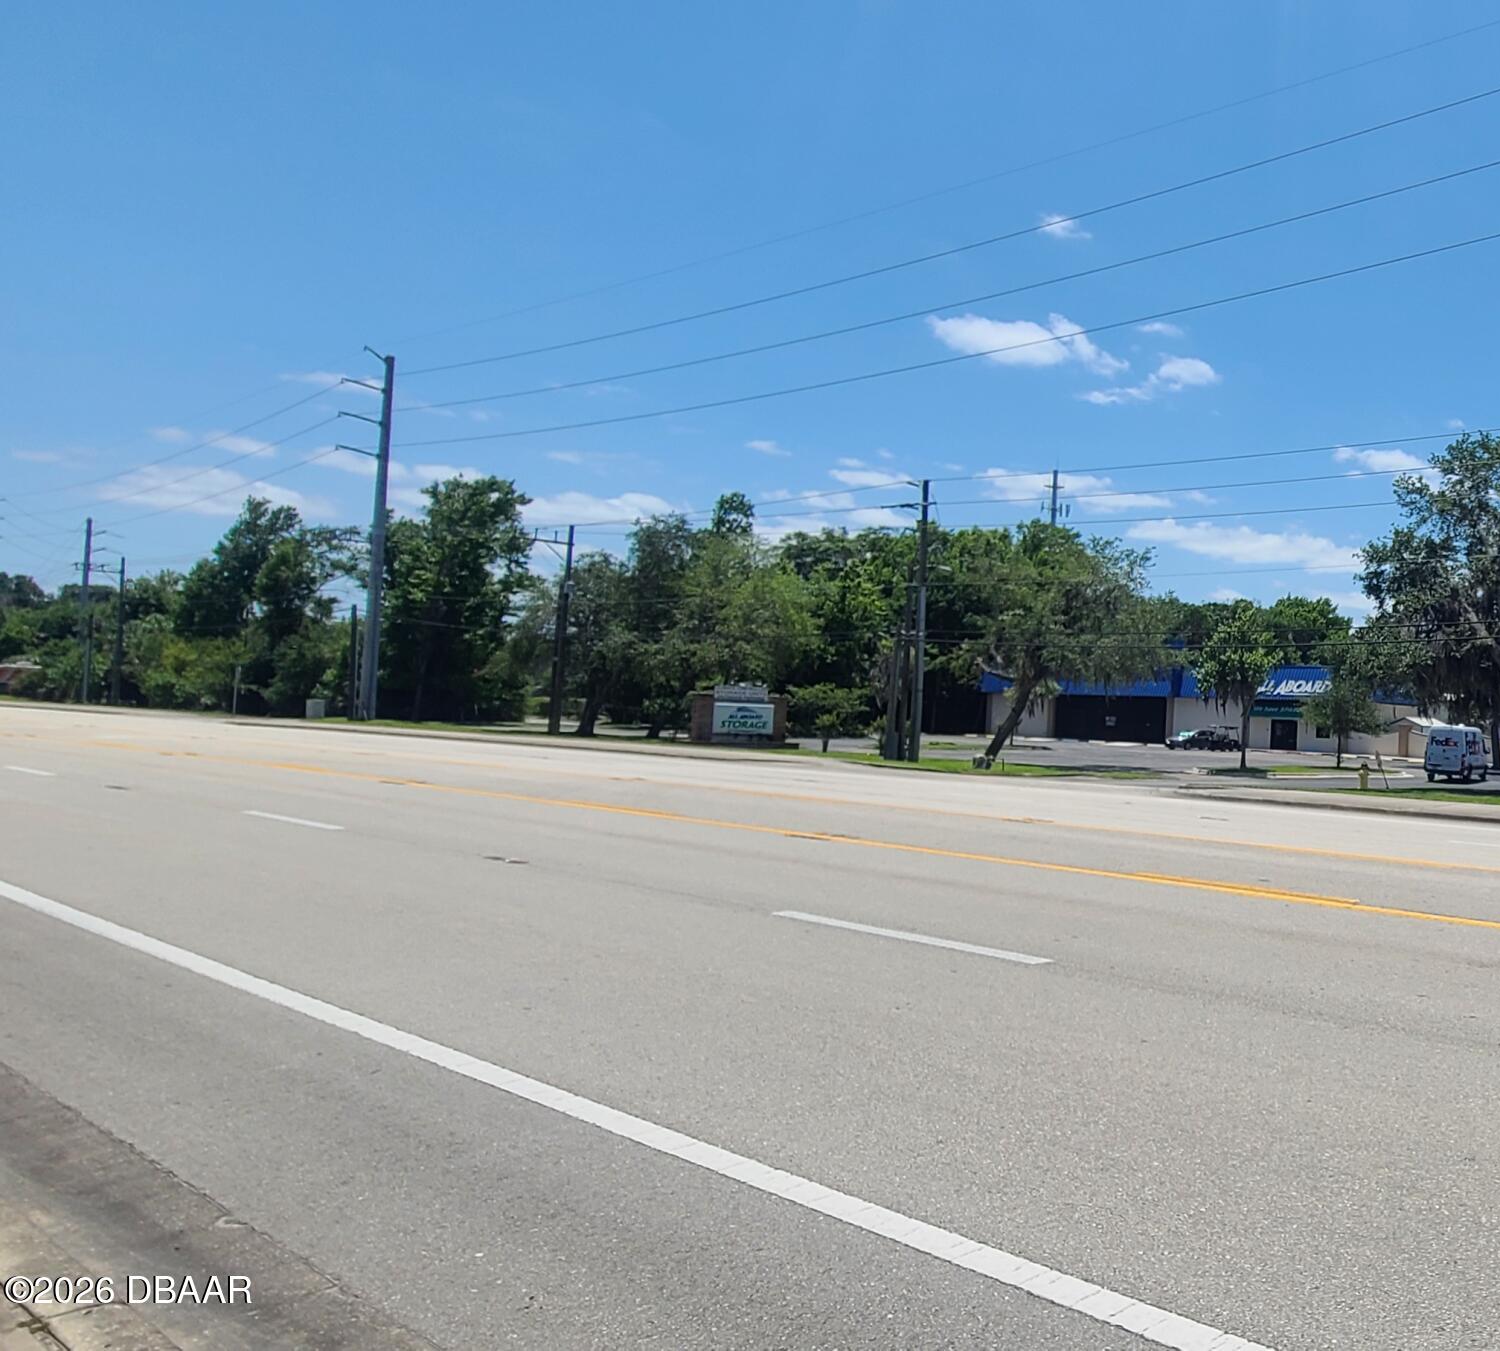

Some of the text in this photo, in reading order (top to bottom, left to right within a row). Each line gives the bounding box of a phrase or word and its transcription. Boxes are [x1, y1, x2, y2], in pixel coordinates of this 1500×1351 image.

[1273, 679, 1334, 695] ABOARD
[720, 720, 769, 729] STORAGE
[1431, 736, 1459, 748] FedEx
